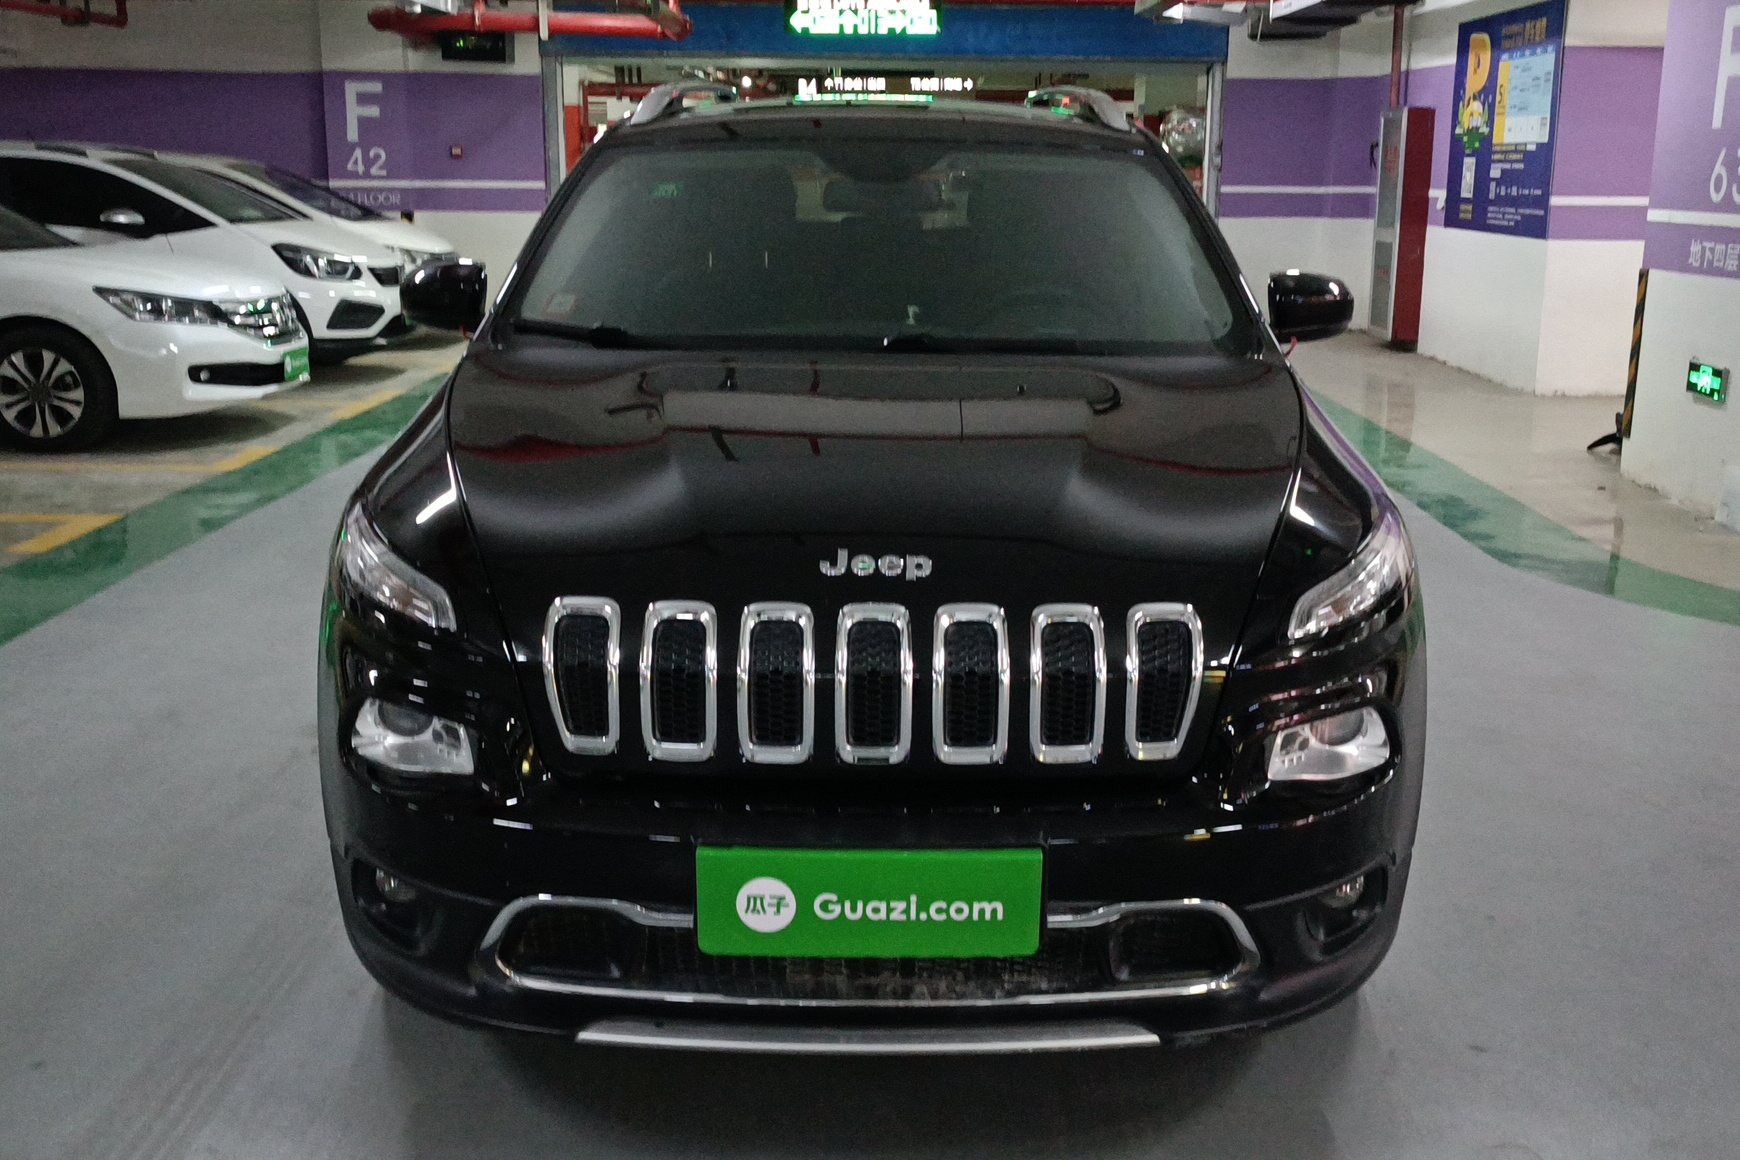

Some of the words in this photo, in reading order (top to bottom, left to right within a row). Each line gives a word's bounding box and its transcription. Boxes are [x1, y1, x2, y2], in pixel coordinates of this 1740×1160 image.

[344, 80, 383, 143] F
[346, 146, 388, 177] 42
[1688, 238, 1740, 273] 地下四层
[819, 547, 933, 582] Jeep
